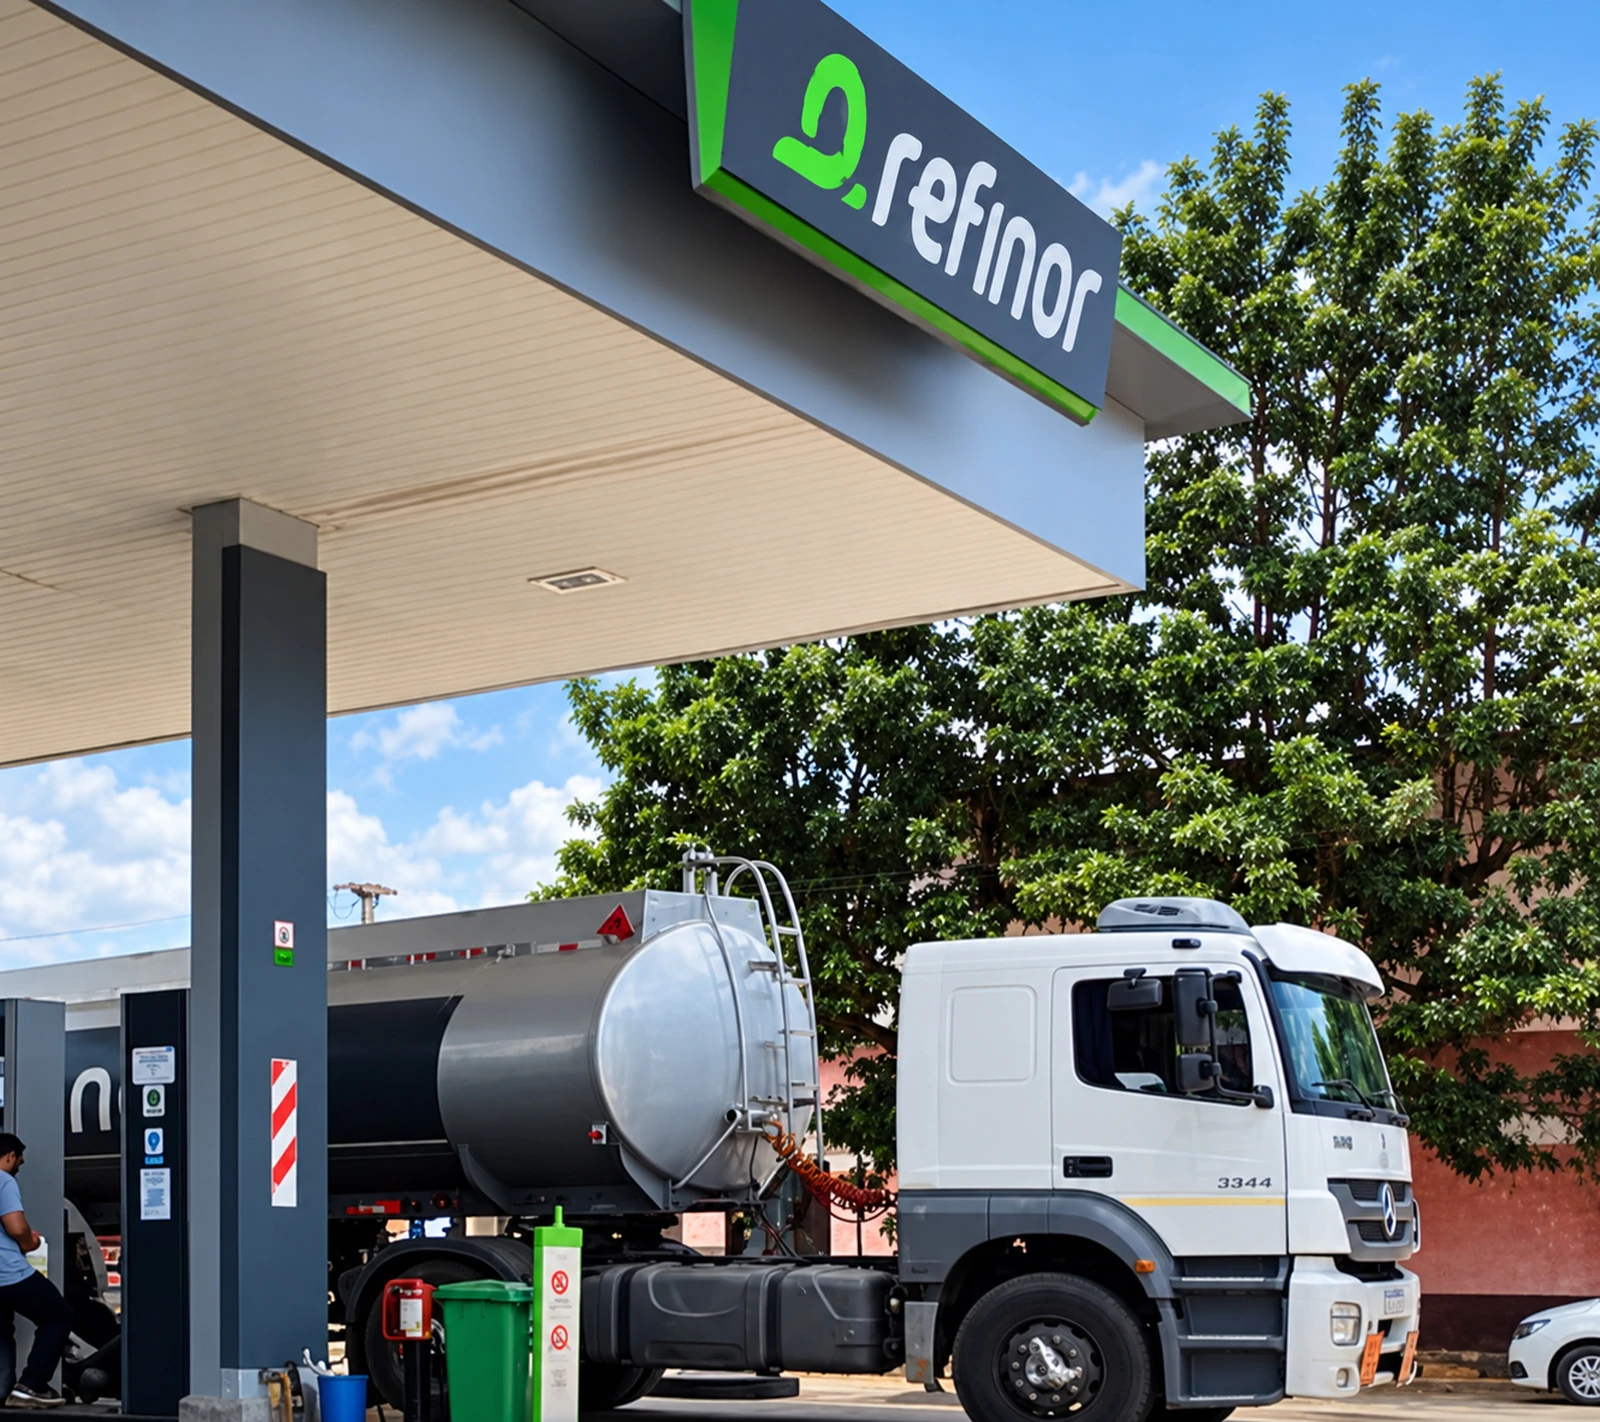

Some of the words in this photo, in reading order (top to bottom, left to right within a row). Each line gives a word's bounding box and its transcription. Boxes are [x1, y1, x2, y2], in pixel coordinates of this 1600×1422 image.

[872, 133, 1102, 353] refinor
[70, 1067, 121, 1133] n
[1217, 1177, 1272, 1189] 3344
